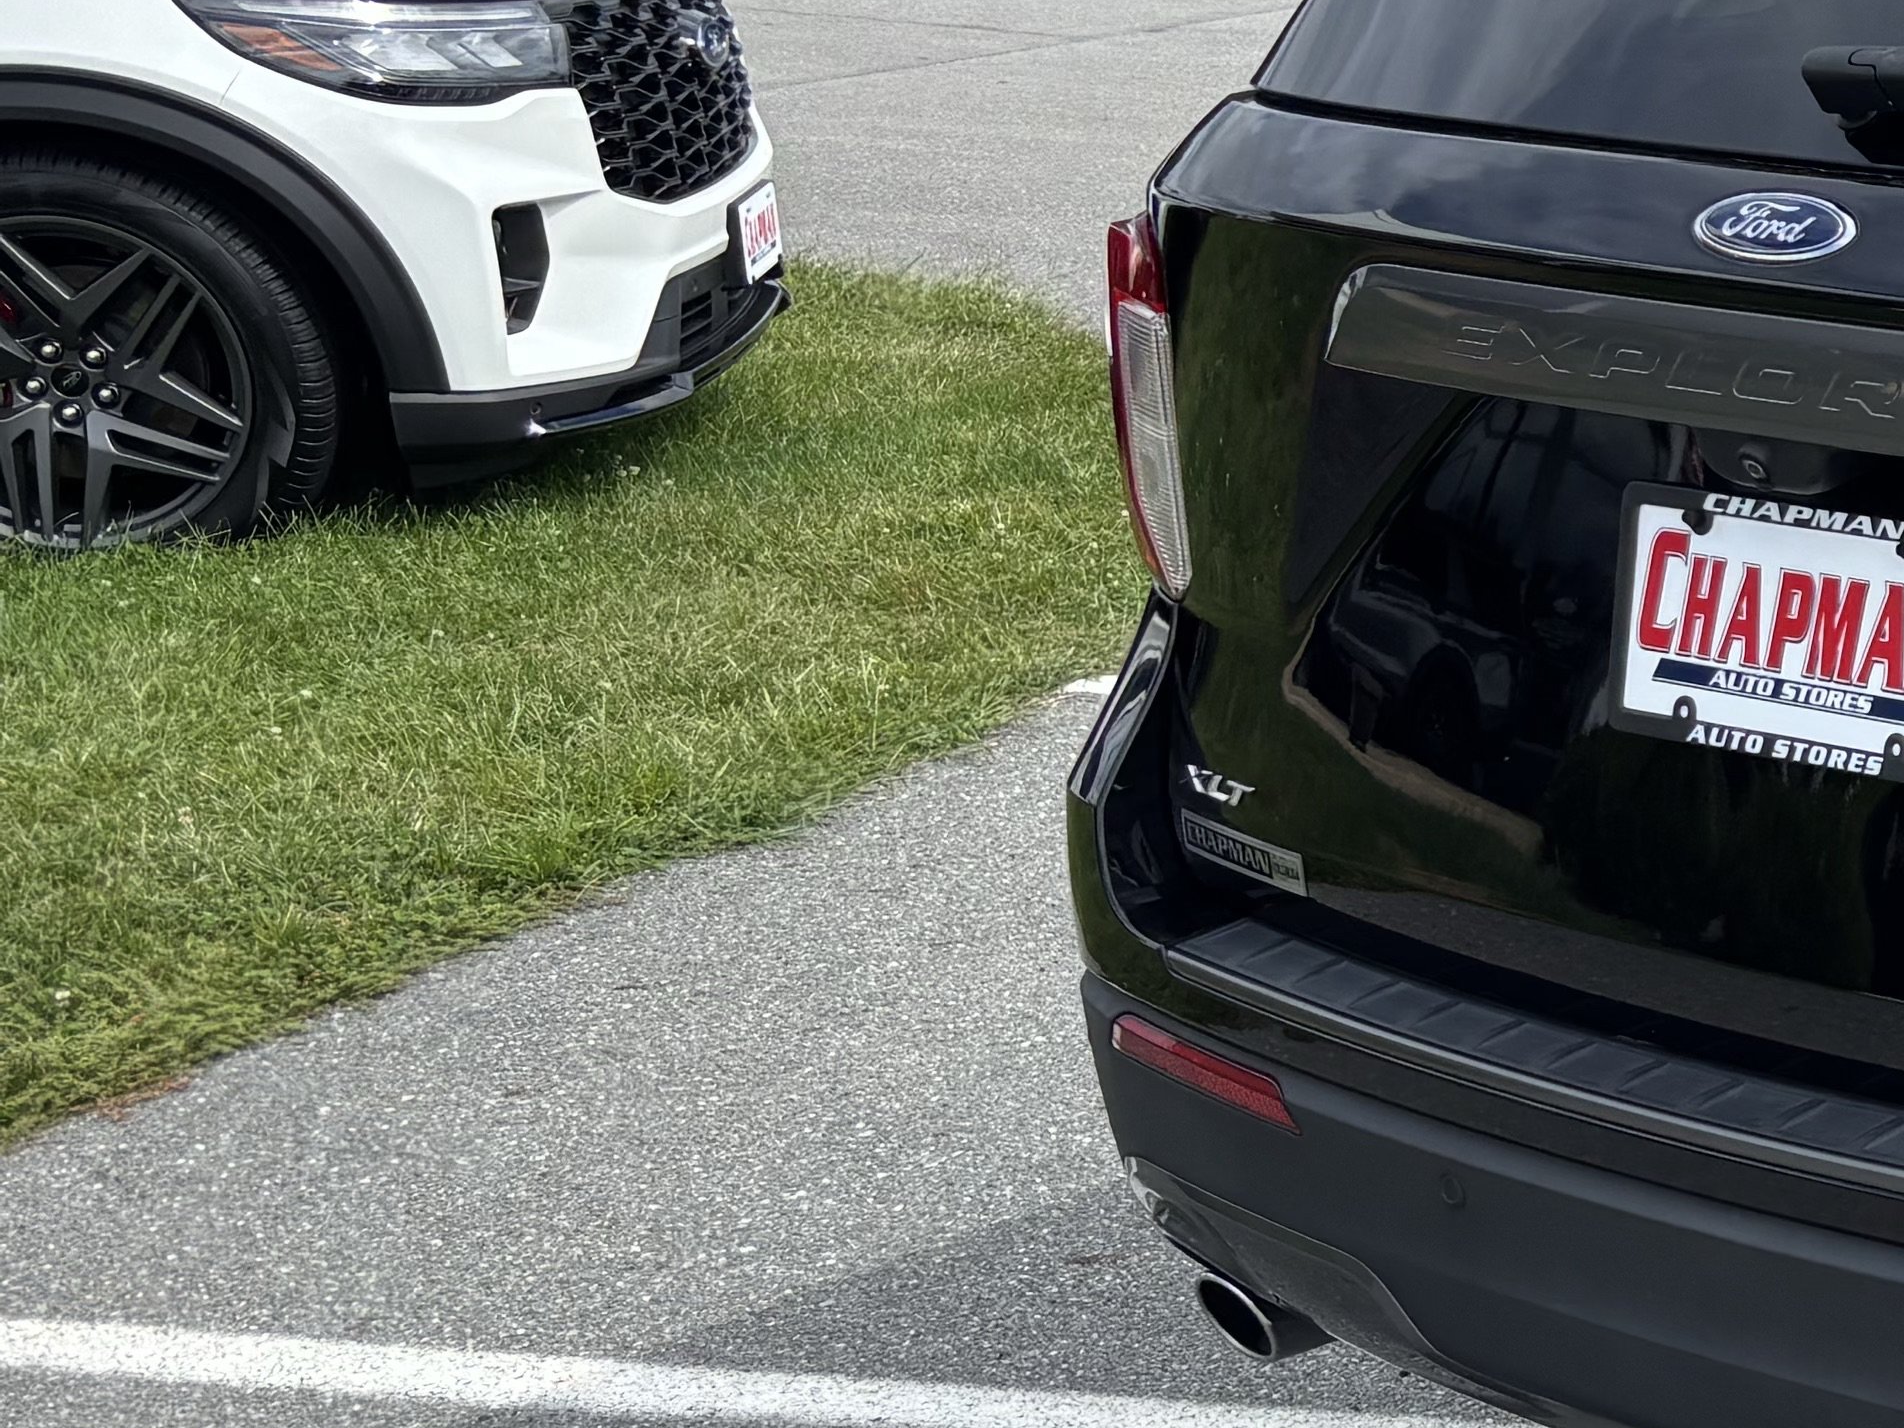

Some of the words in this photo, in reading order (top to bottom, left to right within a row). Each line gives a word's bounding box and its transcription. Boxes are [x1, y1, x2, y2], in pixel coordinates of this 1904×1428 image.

[1722, 201, 1806, 243] Ford
[1709, 671, 1773, 698] AUTO
[1780, 683, 1875, 715] STORES
[1686, 723, 1764, 755] AUTO
[1772, 740, 1884, 776] STORES
[1182, 764, 1256, 807] XLT
[1186, 821, 1271, 876] CHAPMAN
